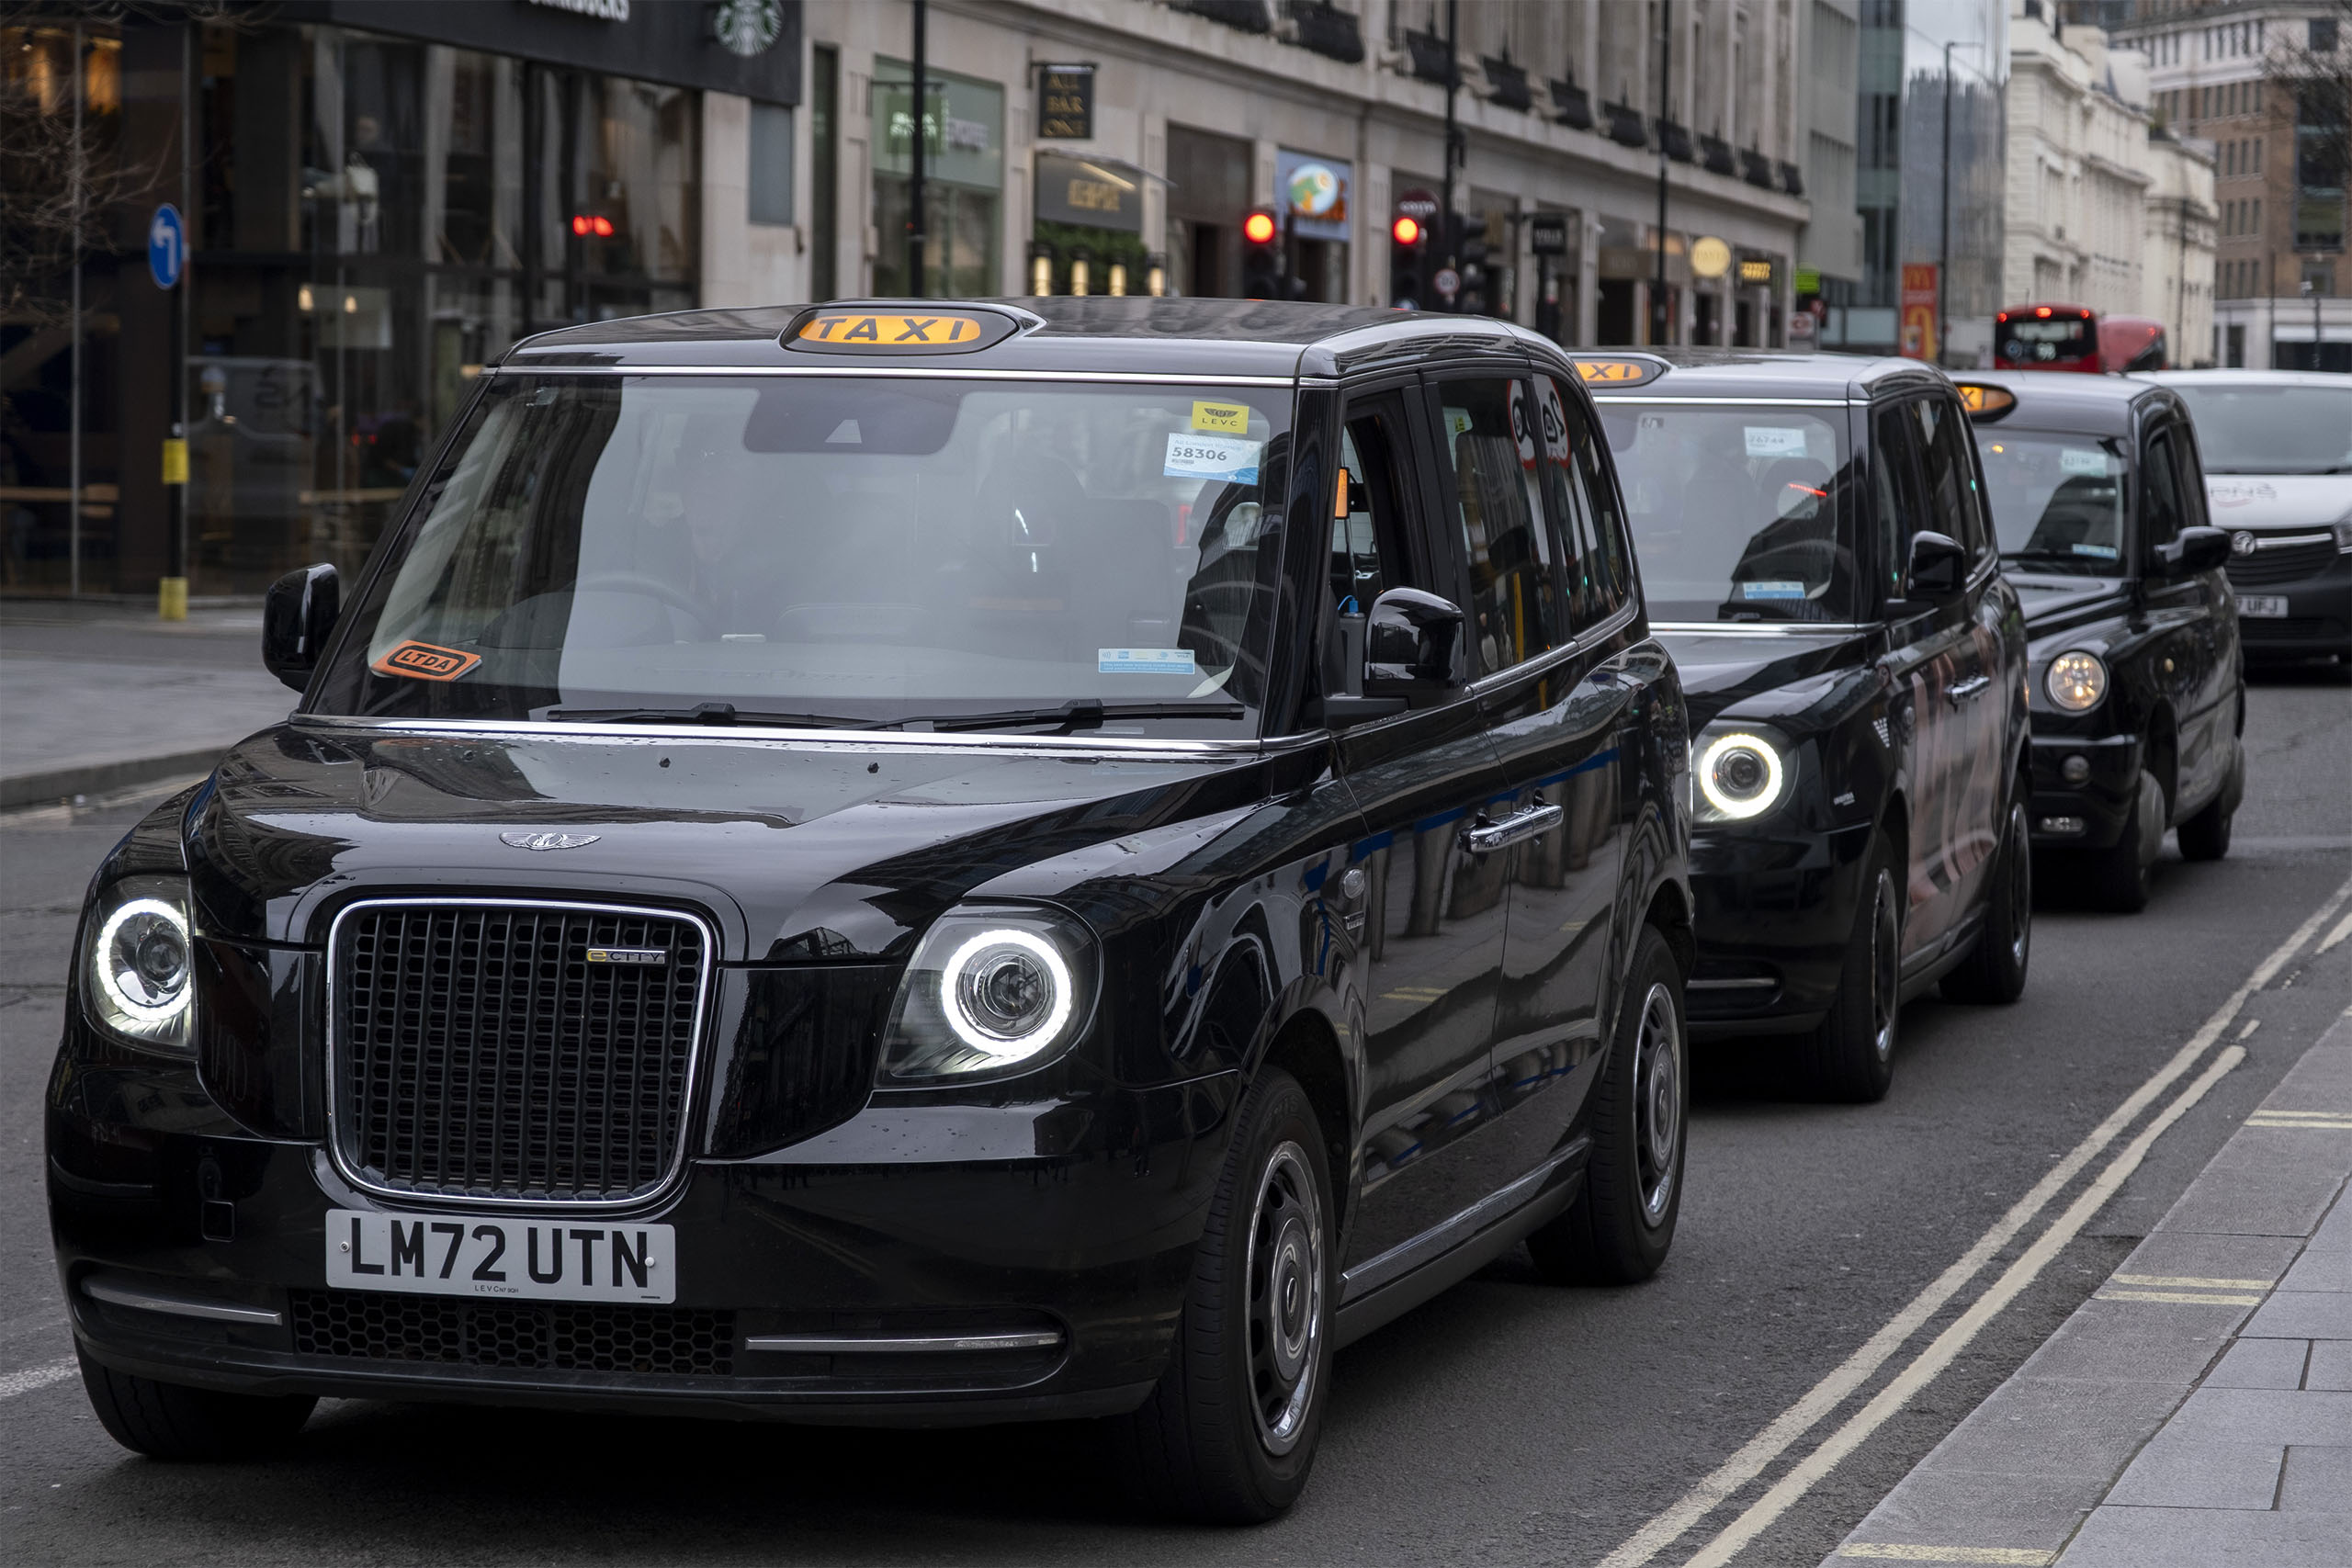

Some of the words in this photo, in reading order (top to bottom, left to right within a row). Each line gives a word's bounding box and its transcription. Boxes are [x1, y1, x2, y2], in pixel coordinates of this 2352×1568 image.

[1046, 96, 1084, 113] BAR
[1043, 118, 1086, 136] ONE
[819, 318, 965, 341] TAXI
[1588, 365, 1632, 378] XI
[1959, 389, 1986, 407] XI
[1202, 418, 1238, 426] LEVC
[1171, 446, 1227, 461] 58306
[401, 651, 450, 671] LTDA
[351, 1217, 506, 1283] LM72
[527, 1227, 649, 1289] UTN
